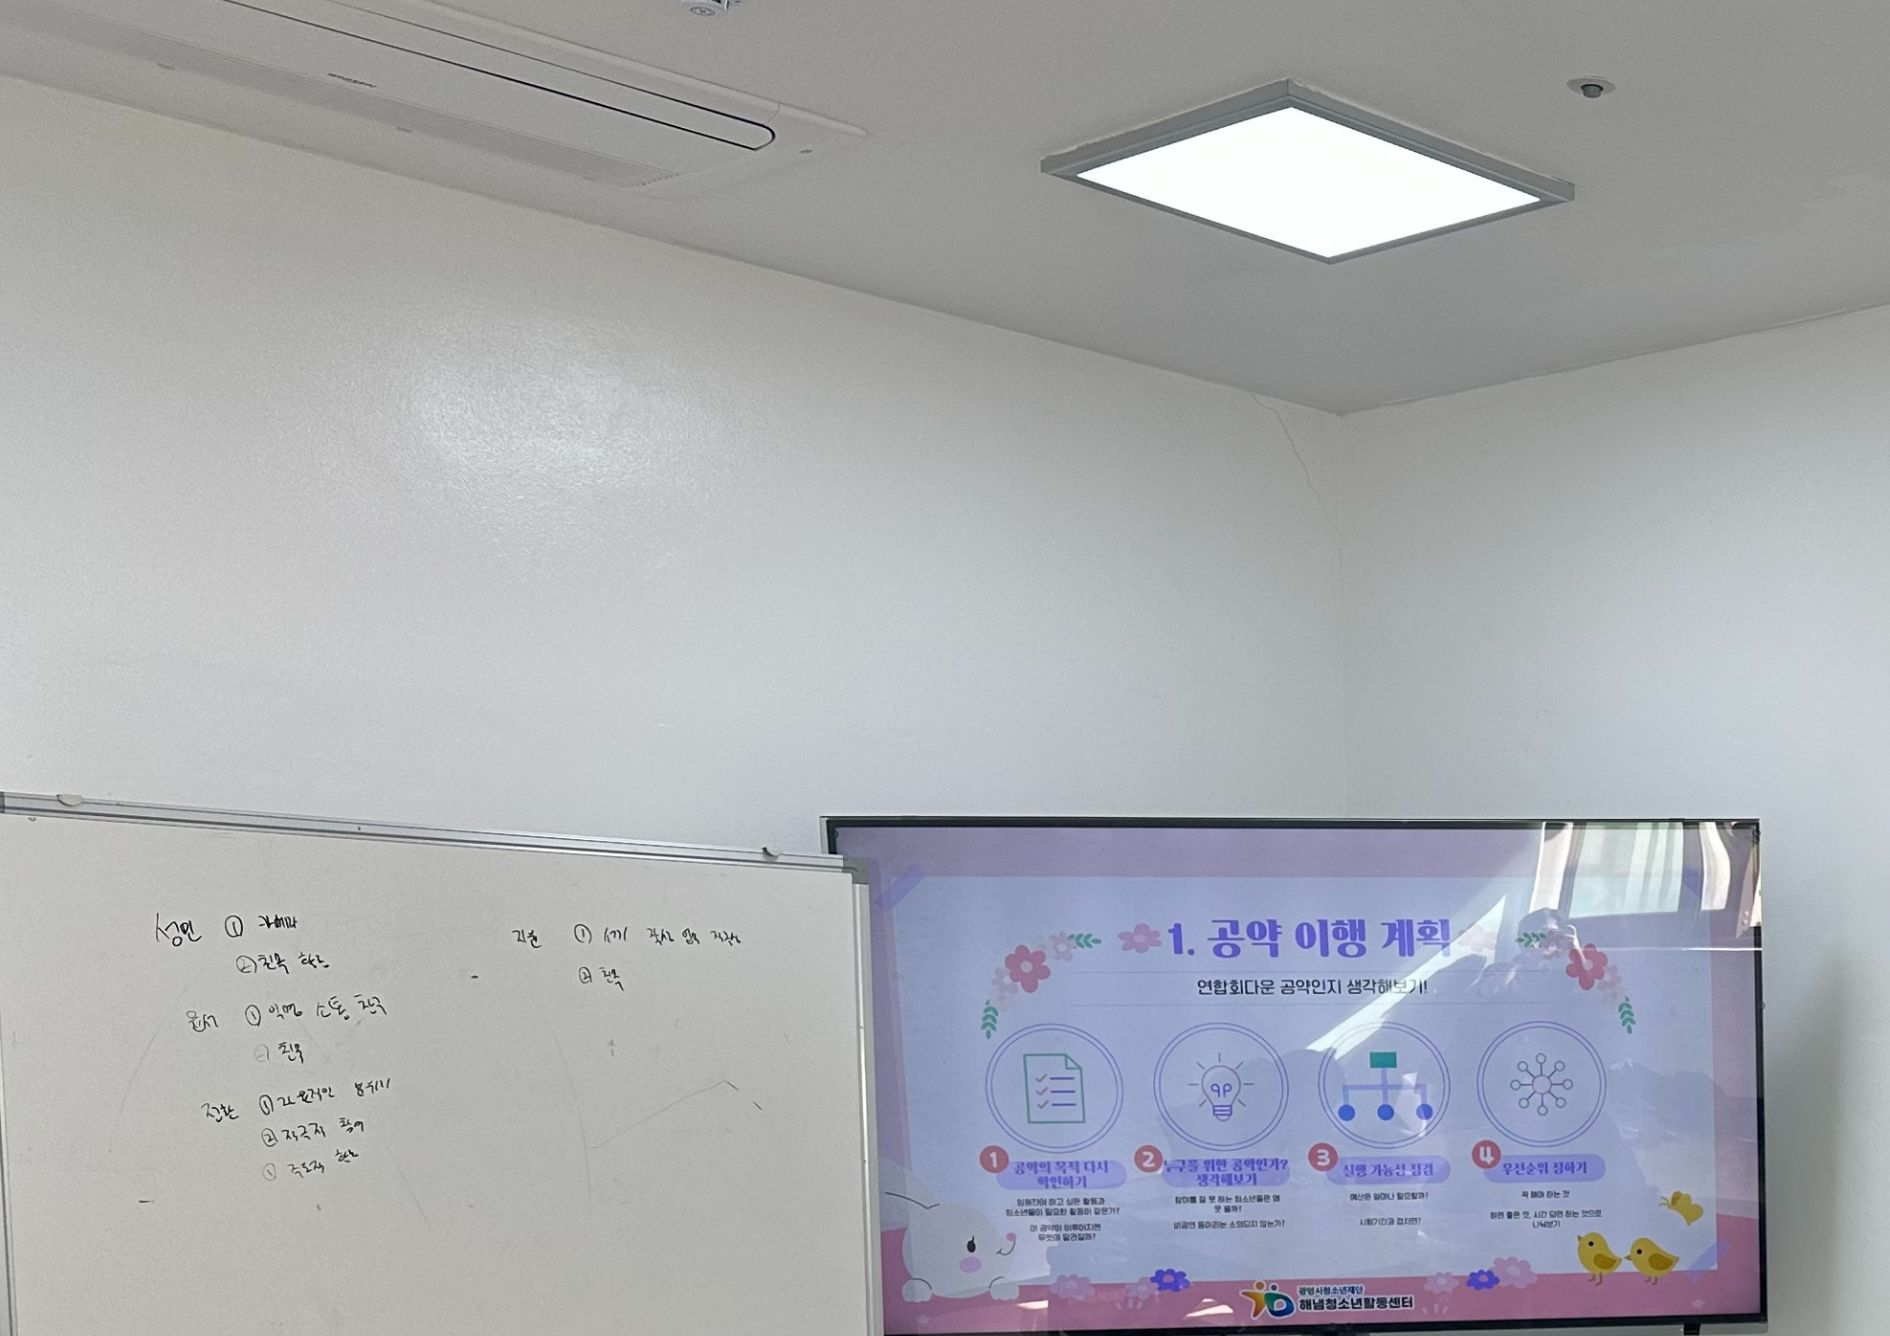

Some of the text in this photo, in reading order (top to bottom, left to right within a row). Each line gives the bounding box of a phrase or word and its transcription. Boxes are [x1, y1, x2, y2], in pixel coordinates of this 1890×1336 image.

[1168, 918, 1450, 958] 1. 공약 이행 계획
[1197, 979, 1428, 995] 연합회다운 공약인지 생각해보기!
[990, 1152, 998, 1167] 1
[1142, 1151, 1155, 1167] 2
[1317, 1150, 1330, 1166] 3
[1479, 1147, 1494, 1166] 4
[1015, 1161, 1108, 1175] 공약의 목적 다시
[1203, 1159, 1227, 1172] 위한
[1232, 1158, 1288, 1172] 공약인가?
[1343, 1164, 1367, 1177] 실행
[1503, 1161, 1587, 1176] 우선순위 정하기
[1038, 1176, 1087, 1189] 확인하기
[1197, 1173, 1257, 1187] 생각해보기
